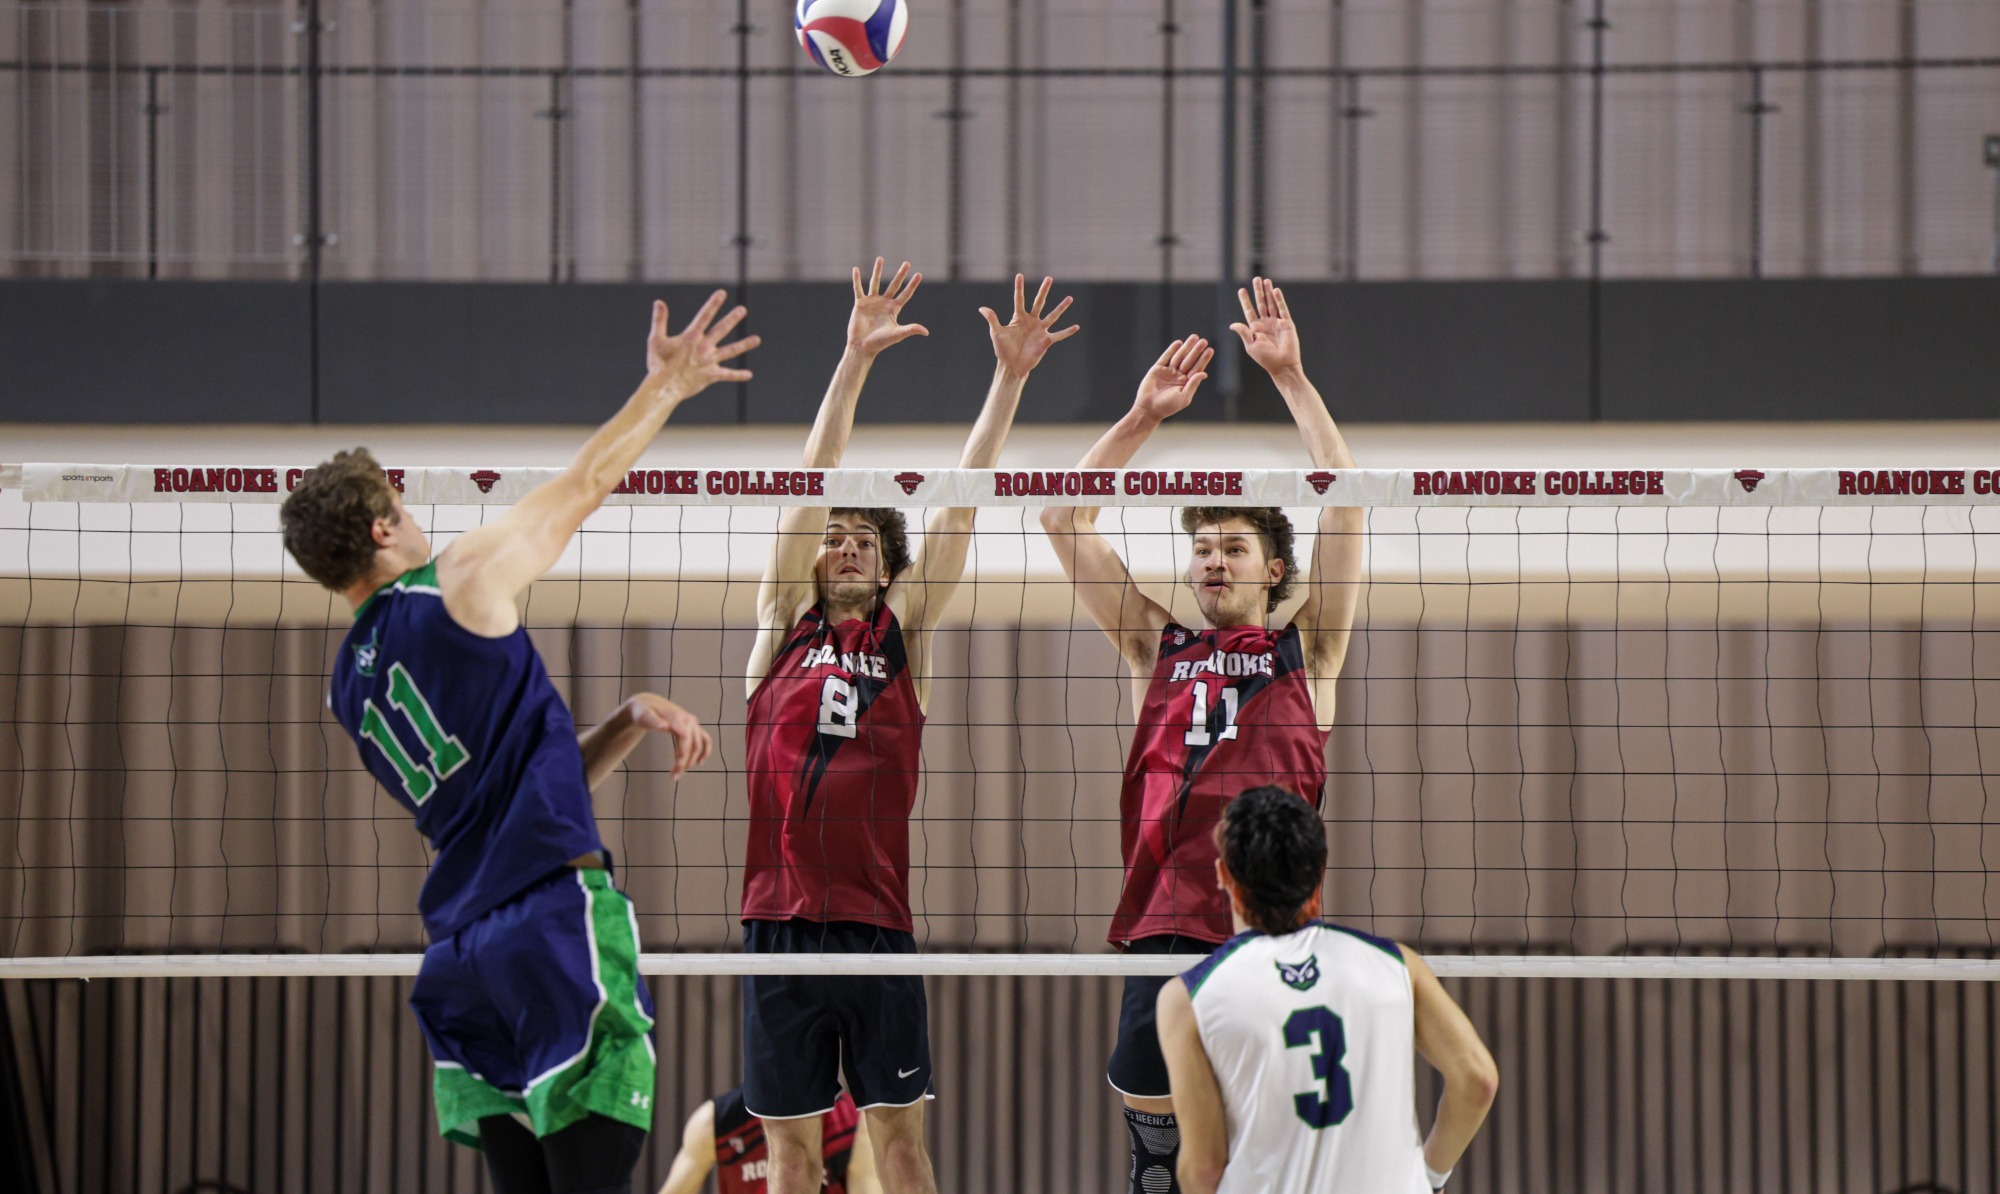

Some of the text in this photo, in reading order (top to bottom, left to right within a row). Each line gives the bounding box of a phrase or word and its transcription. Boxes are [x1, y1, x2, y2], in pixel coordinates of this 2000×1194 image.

[62, 474, 85, 482] sports
[154, 468, 278, 493] ROANOKE
[706, 471, 824, 496] COLLEGE
[994, 472, 1243, 496] ROANOKE COLLEGE
[1413, 471, 1664, 496] ROANOKE COLLEGE
[1838, 470, 1965, 495] ROANOKE
[817, 674, 859, 739] 8
[1184, 681, 1239, 746] 11
[359, 661, 471, 807] 11
[1282, 1005, 1354, 1130] 3
[1136, 1113, 1175, 1126] NEENCA
